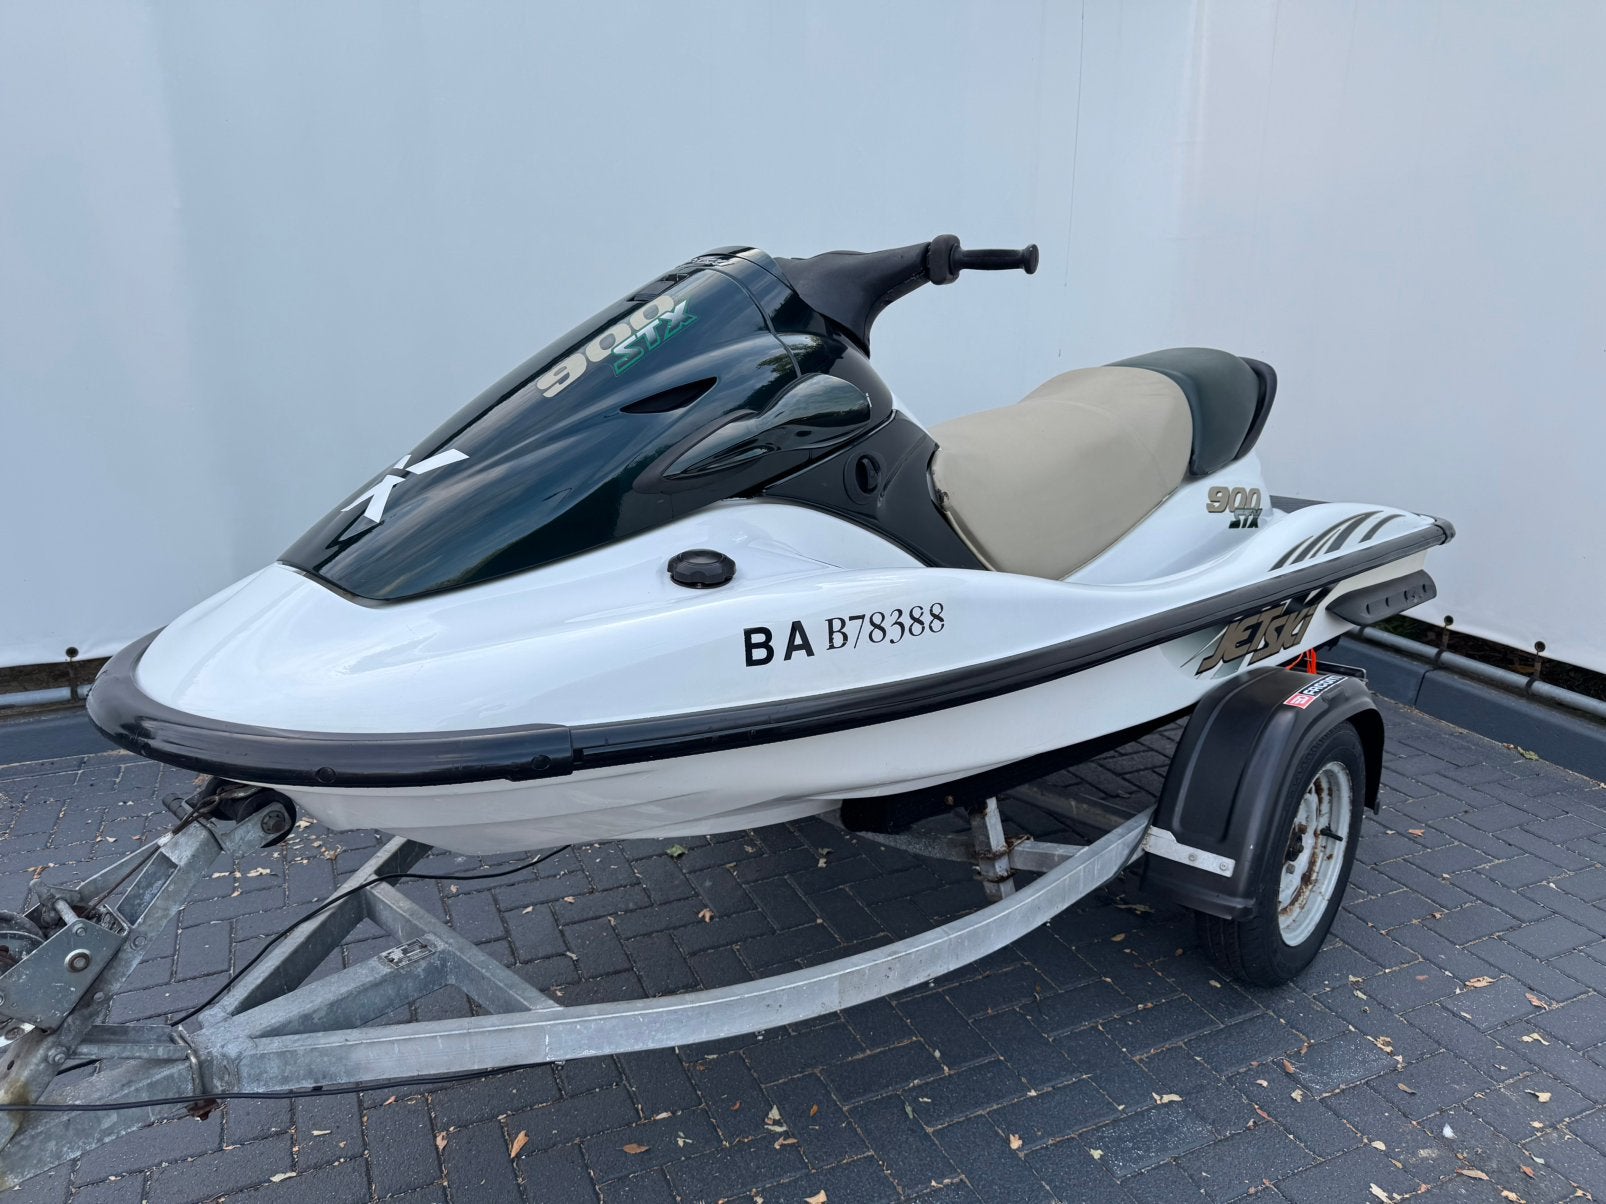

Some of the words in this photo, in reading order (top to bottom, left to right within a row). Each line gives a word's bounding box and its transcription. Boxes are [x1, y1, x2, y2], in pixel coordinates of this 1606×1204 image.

[536, 295, 675, 398] 900
[611, 300, 698, 376] STX
[1206, 486, 1262, 513] 900
[1229, 507, 1263, 528] STX
[825, 602, 945, 650] B78388
